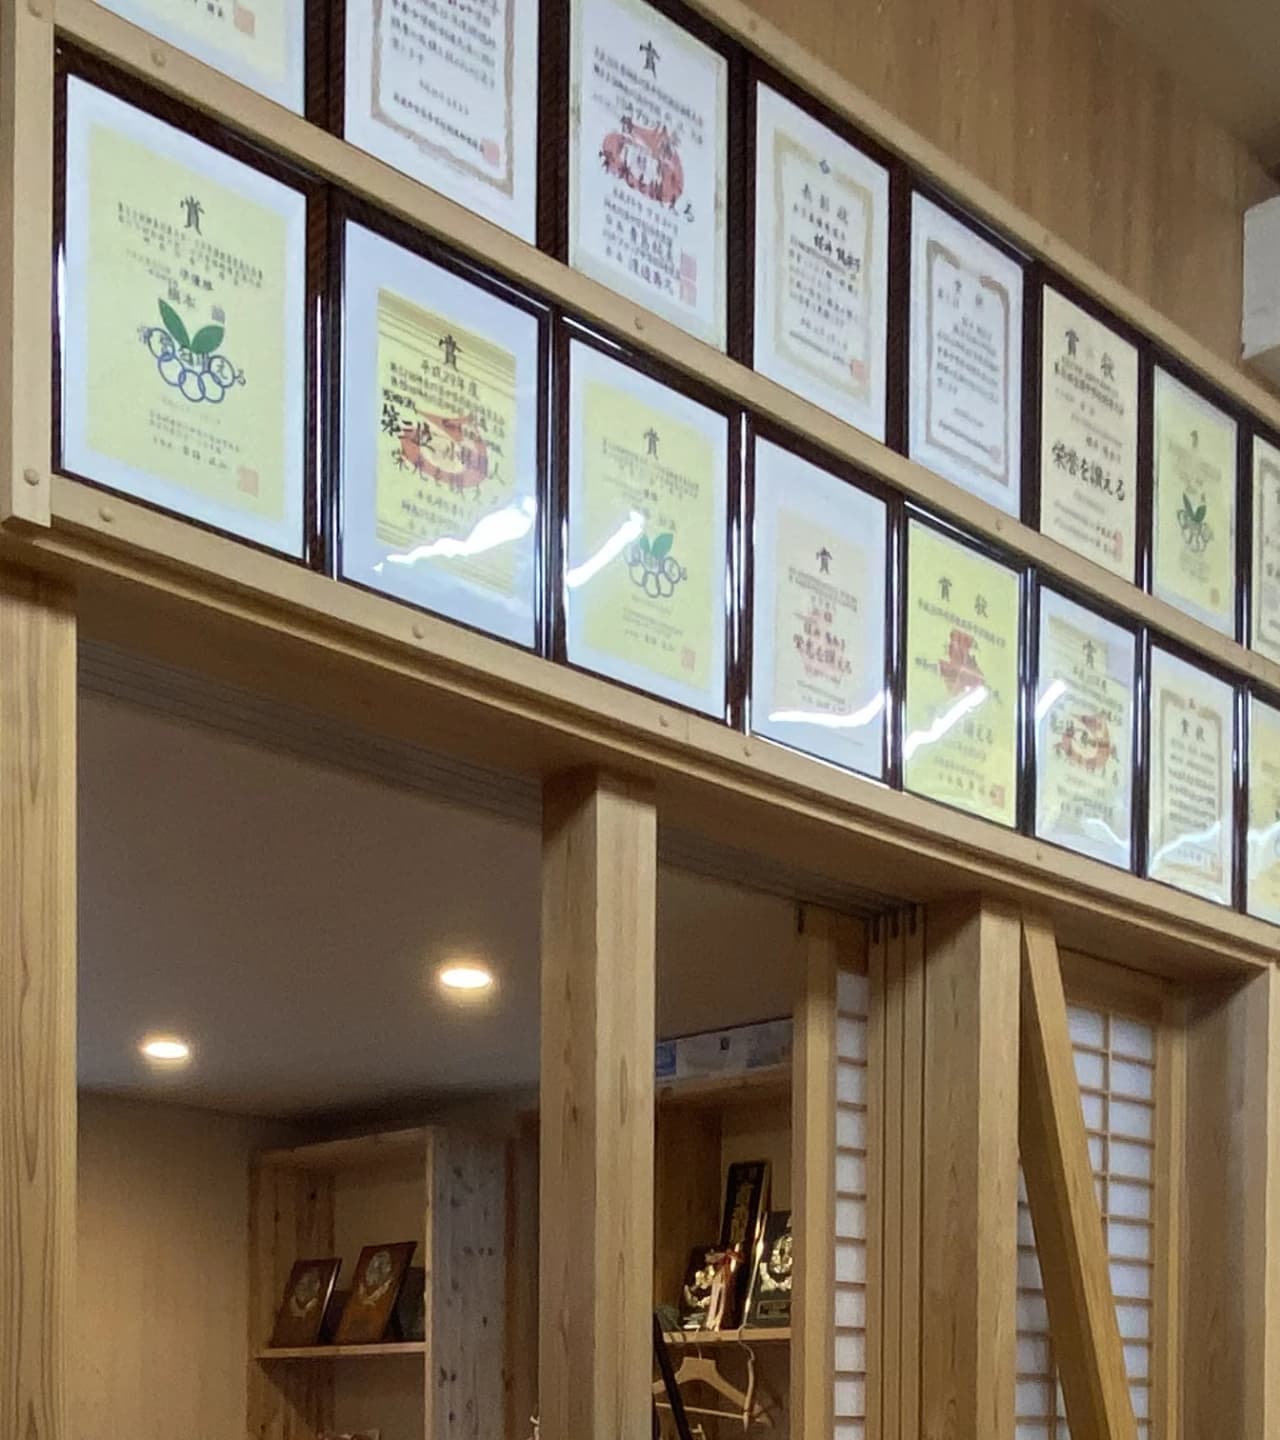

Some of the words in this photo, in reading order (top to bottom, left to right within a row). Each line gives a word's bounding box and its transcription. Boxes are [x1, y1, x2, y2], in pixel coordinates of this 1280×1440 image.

[640, 39, 661, 79] 賞
[180, 194, 206, 236] 賞
[439, 333, 464, 373] 賞
[1064, 328, 1116, 383] 賞状
[1051, 437, 1126, 502] 栄誉を讃える
